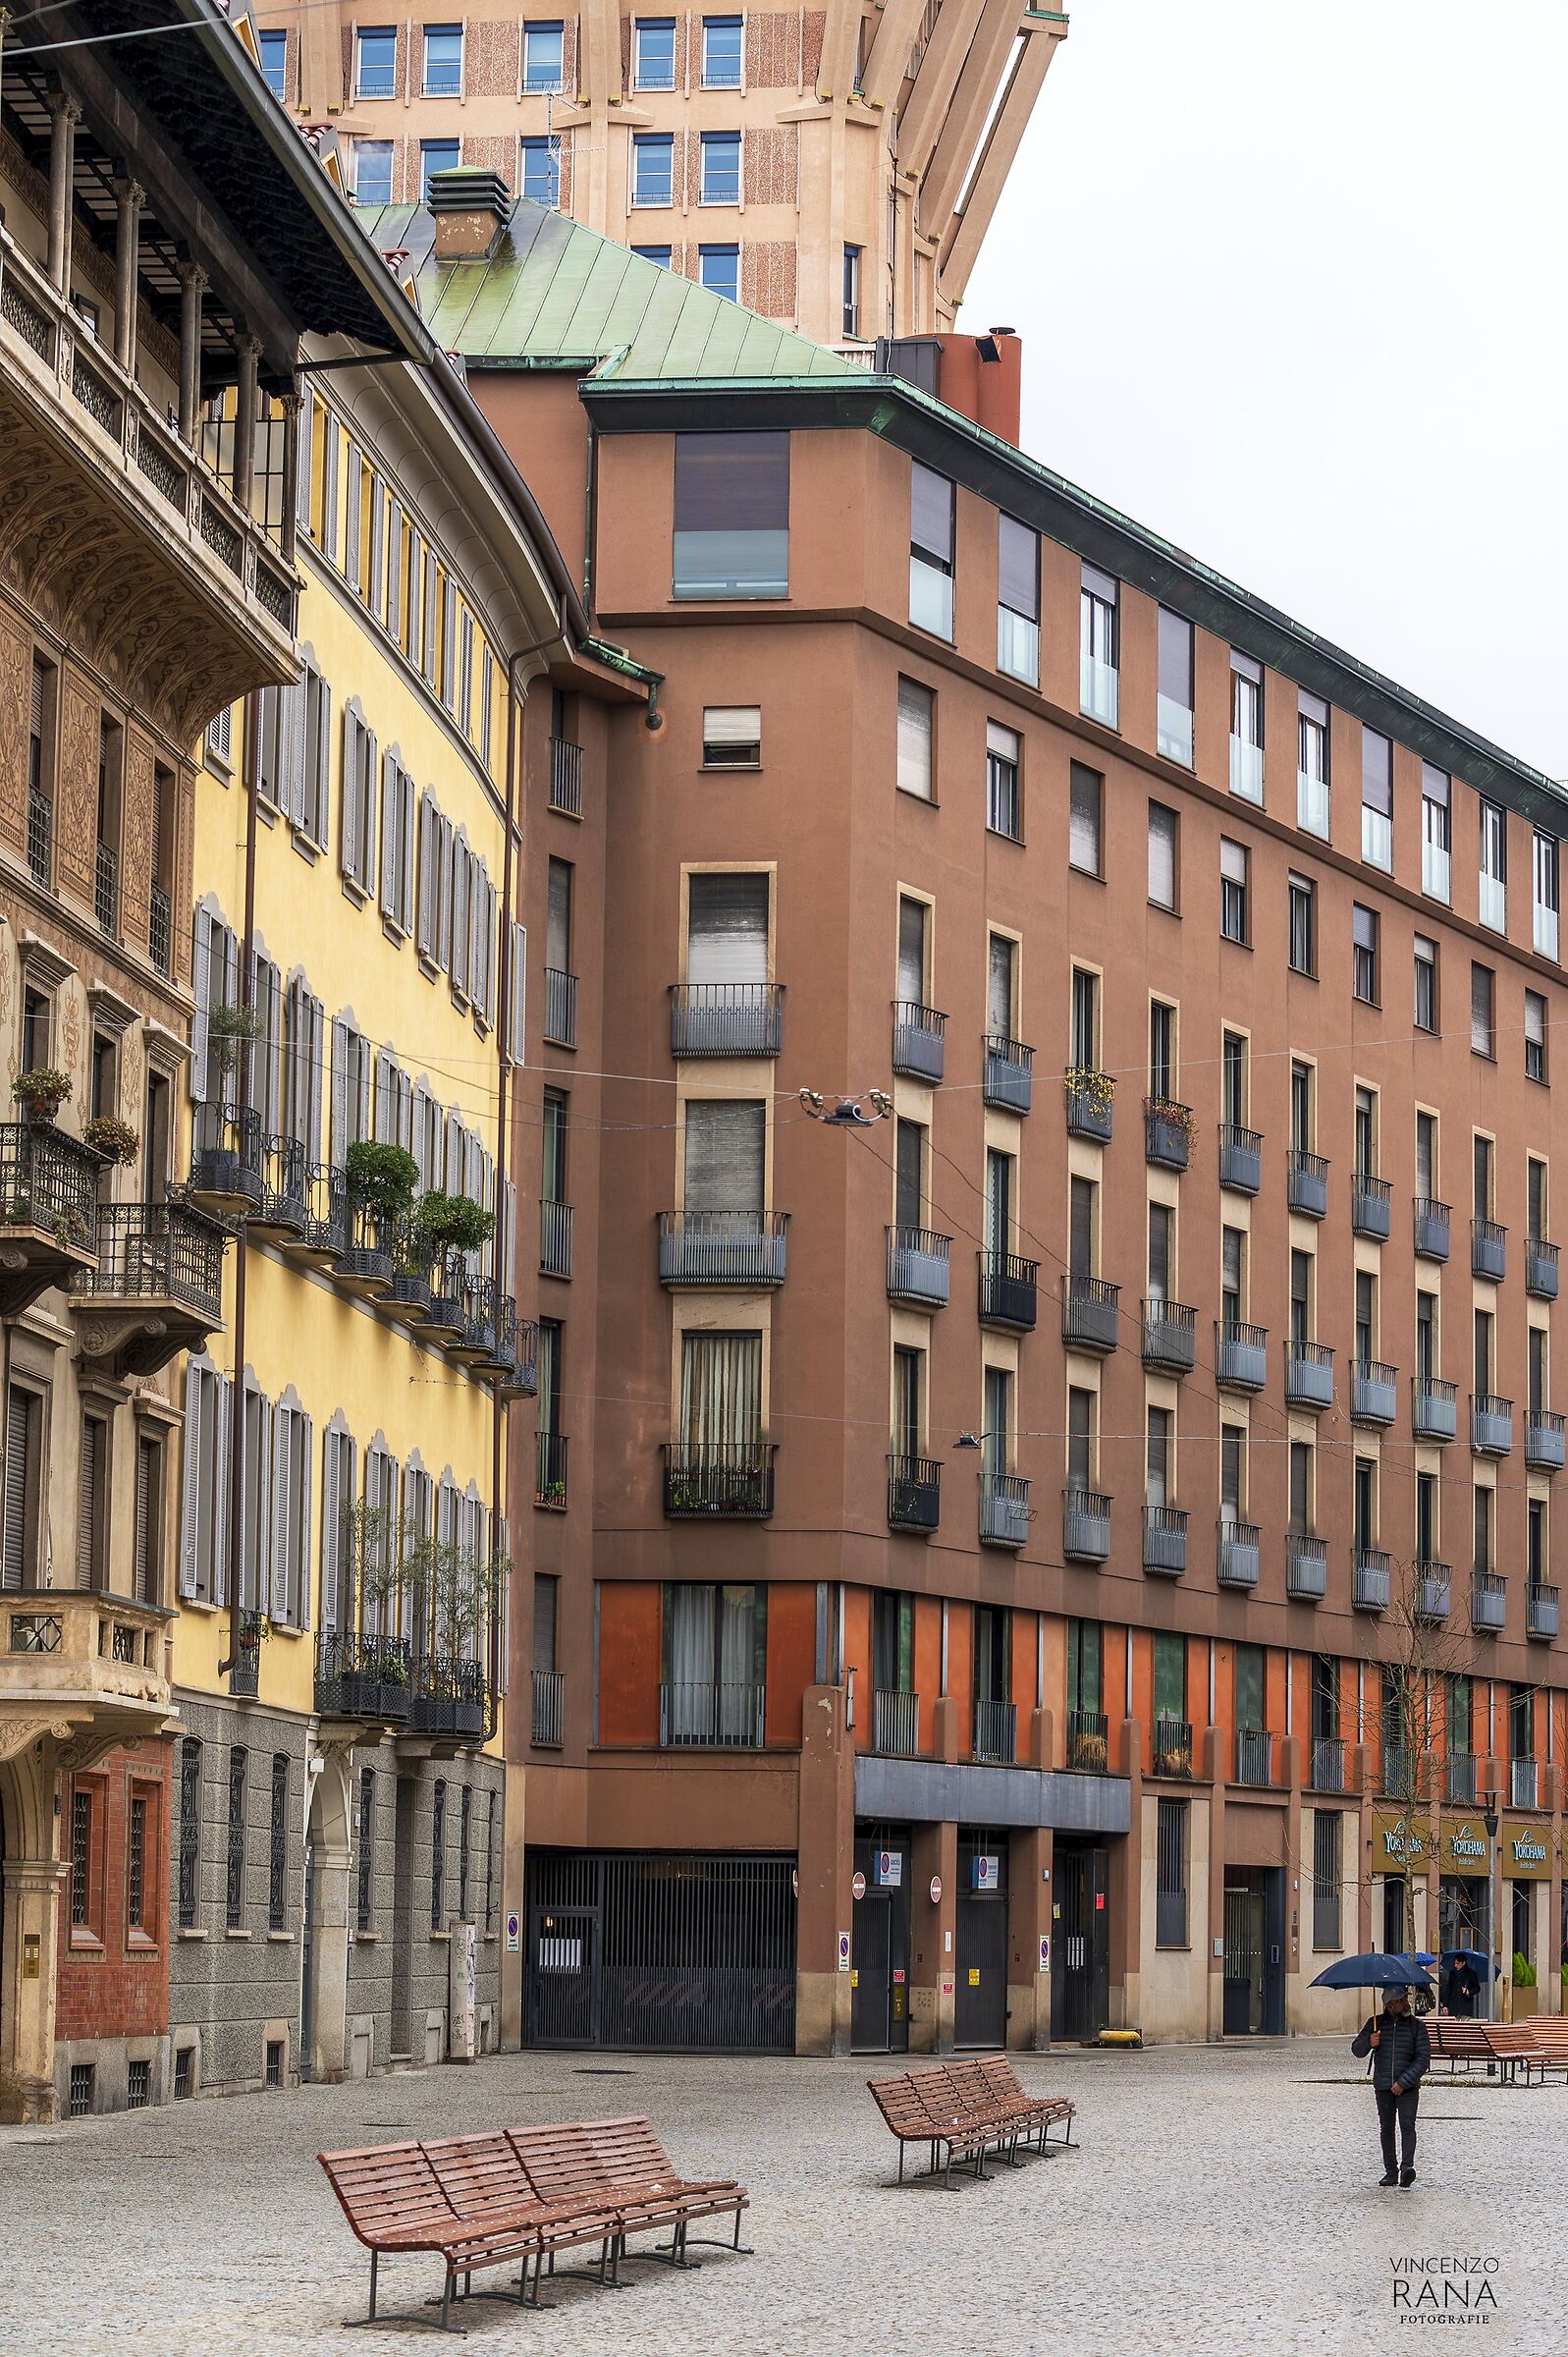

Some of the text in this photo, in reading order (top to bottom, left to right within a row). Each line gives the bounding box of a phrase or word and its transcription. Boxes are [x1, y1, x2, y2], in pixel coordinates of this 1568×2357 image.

[1382, 1832, 1423, 1853] YOKOAMA
[1449, 1836, 1487, 1856] YOKOHAMA
[1511, 1839, 1546, 1860] YOKOHAMA
